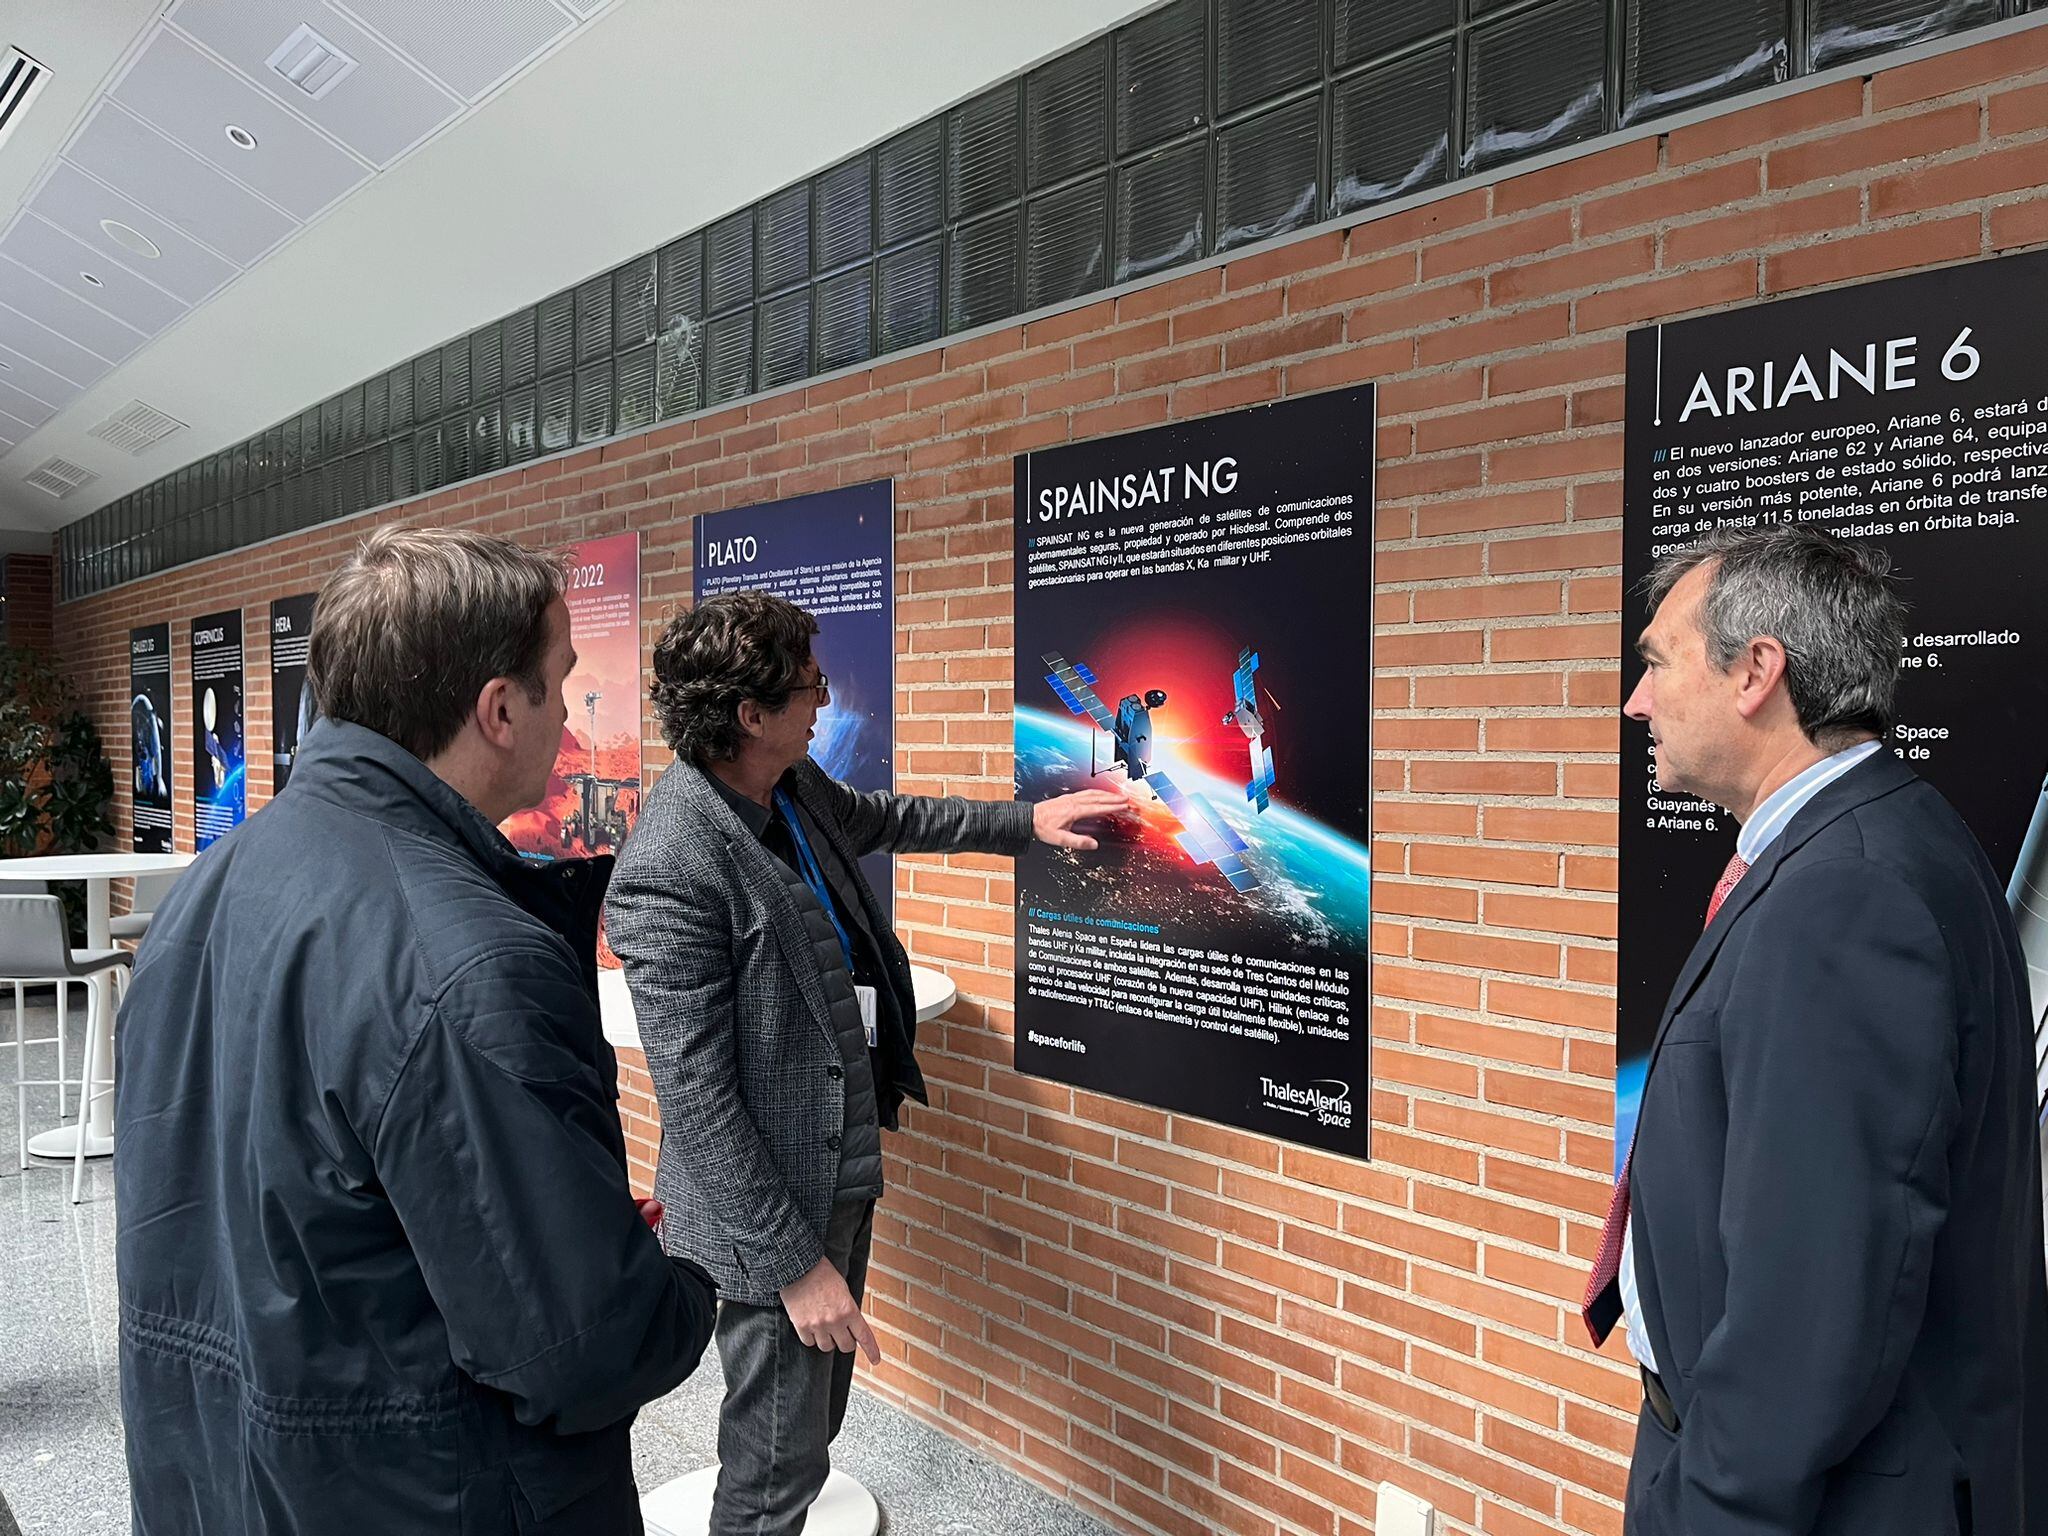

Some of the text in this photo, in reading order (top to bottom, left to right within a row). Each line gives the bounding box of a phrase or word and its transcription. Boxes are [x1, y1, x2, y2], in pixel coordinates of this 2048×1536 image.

[1678, 326, 1981, 424] ARIANE 6
[1670, 446, 1683, 461] El
[1690, 442, 1733, 458] nuevo
[1740, 431, 1804, 451] lanzador
[1811, 422, 1879, 441] europeo,
[1887, 413, 1941, 432] Ariane
[1949, 407, 1964, 424] 6,
[1974, 398, 2027, 420] estará
[1653, 420, 2046, 481] en dos versiones: Ariane 62 y Ariane 64, equipa
[1652, 441, 2048, 500] dos y cuatro boosters de estado sólido, respectiva
[1039, 456, 1239, 522] SPAINSAT NG
[1653, 464, 2047, 518] En su versión más potente, Ariane 6 podrá lanz
[1036, 494, 1352, 547] SPAINSAT NG es la nueva generación de satélites de comunicaciones
[1652, 522, 1689, 537] carga
[1694, 518, 1712, 532] de
[1717, 514, 1756, 532] hasta
[1797, 502, 1873, 522] toneladas
[1879, 501, 1899, 514] en
[1905, 493, 1952, 511] órbita
[1958, 490, 1980, 506] de
[1986, 483, 2047, 503] transfe
[1898, 520, 1919, 533] en
[1924, 514, 1971, 531] órbita
[1977, 509, 2019, 528] baja.
[1058, 556, 1095, 571] SPAINSAT
[1096, 554, 1108, 566] NG
[1112, 556, 1117, 567] y
[1125, 553, 1140, 565] que
[1140, 548, 1170, 561] estarán
[1170, 544, 1205, 558] situados
[1205, 543, 1216, 554] en
[1217, 538, 1260, 552] diferentes
[1261, 532, 1309, 549] posiciones
[1310, 526, 1352, 541] orbitales
[1089, 542, 1120, 555] seguras,
[1124, 534, 1162, 552] propiedad
[1165, 535, 1170, 546] y
[1173, 528, 1208, 545] operado
[1211, 527, 1226, 540] por
[1229, 520, 1270, 535] Hisdesat.
[1274, 512, 1329, 530] Comprende
[1333, 509, 1352, 522] dos
[708, 535, 758, 568] PLATO
[1086, 571, 1103, 583] para
[1104, 568, 1129, 581] operar
[1130, 567, 1140, 577] en
[1141, 564, 1153, 575] las
[1154, 561, 1184, 574] bandas
[1186, 559, 1195, 571] X,
[1197, 557, 1209, 569] Ka
[1241, 555, 1247, 567] y
[1249, 550, 1271, 563] UHF.
[572, 563, 604, 589] 2022
[275, 616, 292, 634] HERA
[1912, 629, 2020, 648] desarrollado
[1926, 653, 1943, 668] 6.
[1895, 724, 1950, 742] Space
[1908, 745, 1931, 760] de
[1646, 797, 1716, 814] Guayanés
[1646, 815, 1719, 831] a Ariane 6.
[1036, 908, 1159, 935] Cargas útiles de comunicaciones
[1028, 923, 1349, 981] Thales Alenia Space en España lidera las cargas útiles de comunicaciones en las
[1028, 974, 1053, 986] servicio
[1053, 977, 1063, 988] de
[1064, 980, 1076, 991] alta
[1077, 983, 1110, 997] velocidad
[1111, 989, 1127, 1004] para
[1129, 992, 1173, 1010] reconfigurar
[1174, 999, 1182, 1010] la
[1183, 1002, 1206, 1017] carga
[1222, 1008, 1266, 1026] totalmente
[1267, 1015, 1304, 1035] flexible),
[1307, 1024, 1349, 1041] unidades
[1027, 1030, 1087, 1054] #spaceforlife
[1259, 1076, 1352, 1115] ThalesAlenia
[1317, 1108, 1352, 1128] Space
